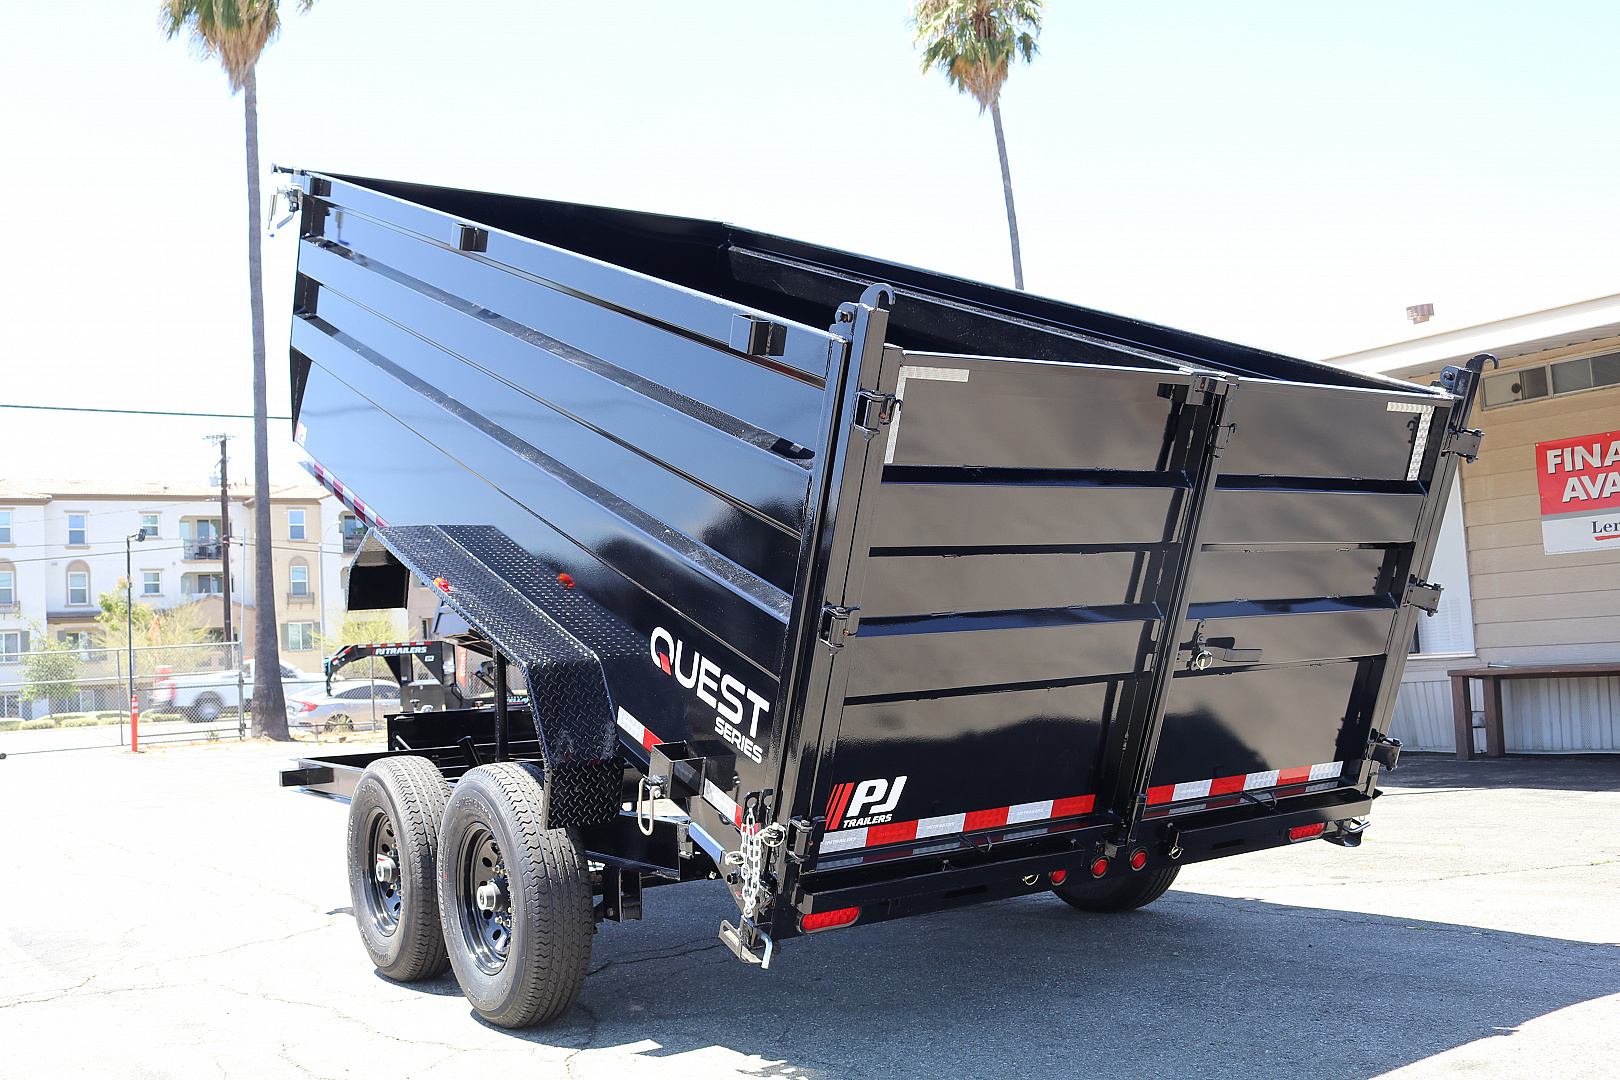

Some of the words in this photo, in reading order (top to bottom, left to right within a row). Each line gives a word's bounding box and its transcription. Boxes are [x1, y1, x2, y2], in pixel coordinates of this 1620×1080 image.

[1546, 440, 1620, 474] FINA
[1561, 471, 1620, 503] AVA
[650, 626, 770, 739] QUEST
[714, 716, 763, 764] SERIES
[846, 775, 908, 818] PJ
[843, 813, 893, 829] TRAILERS
